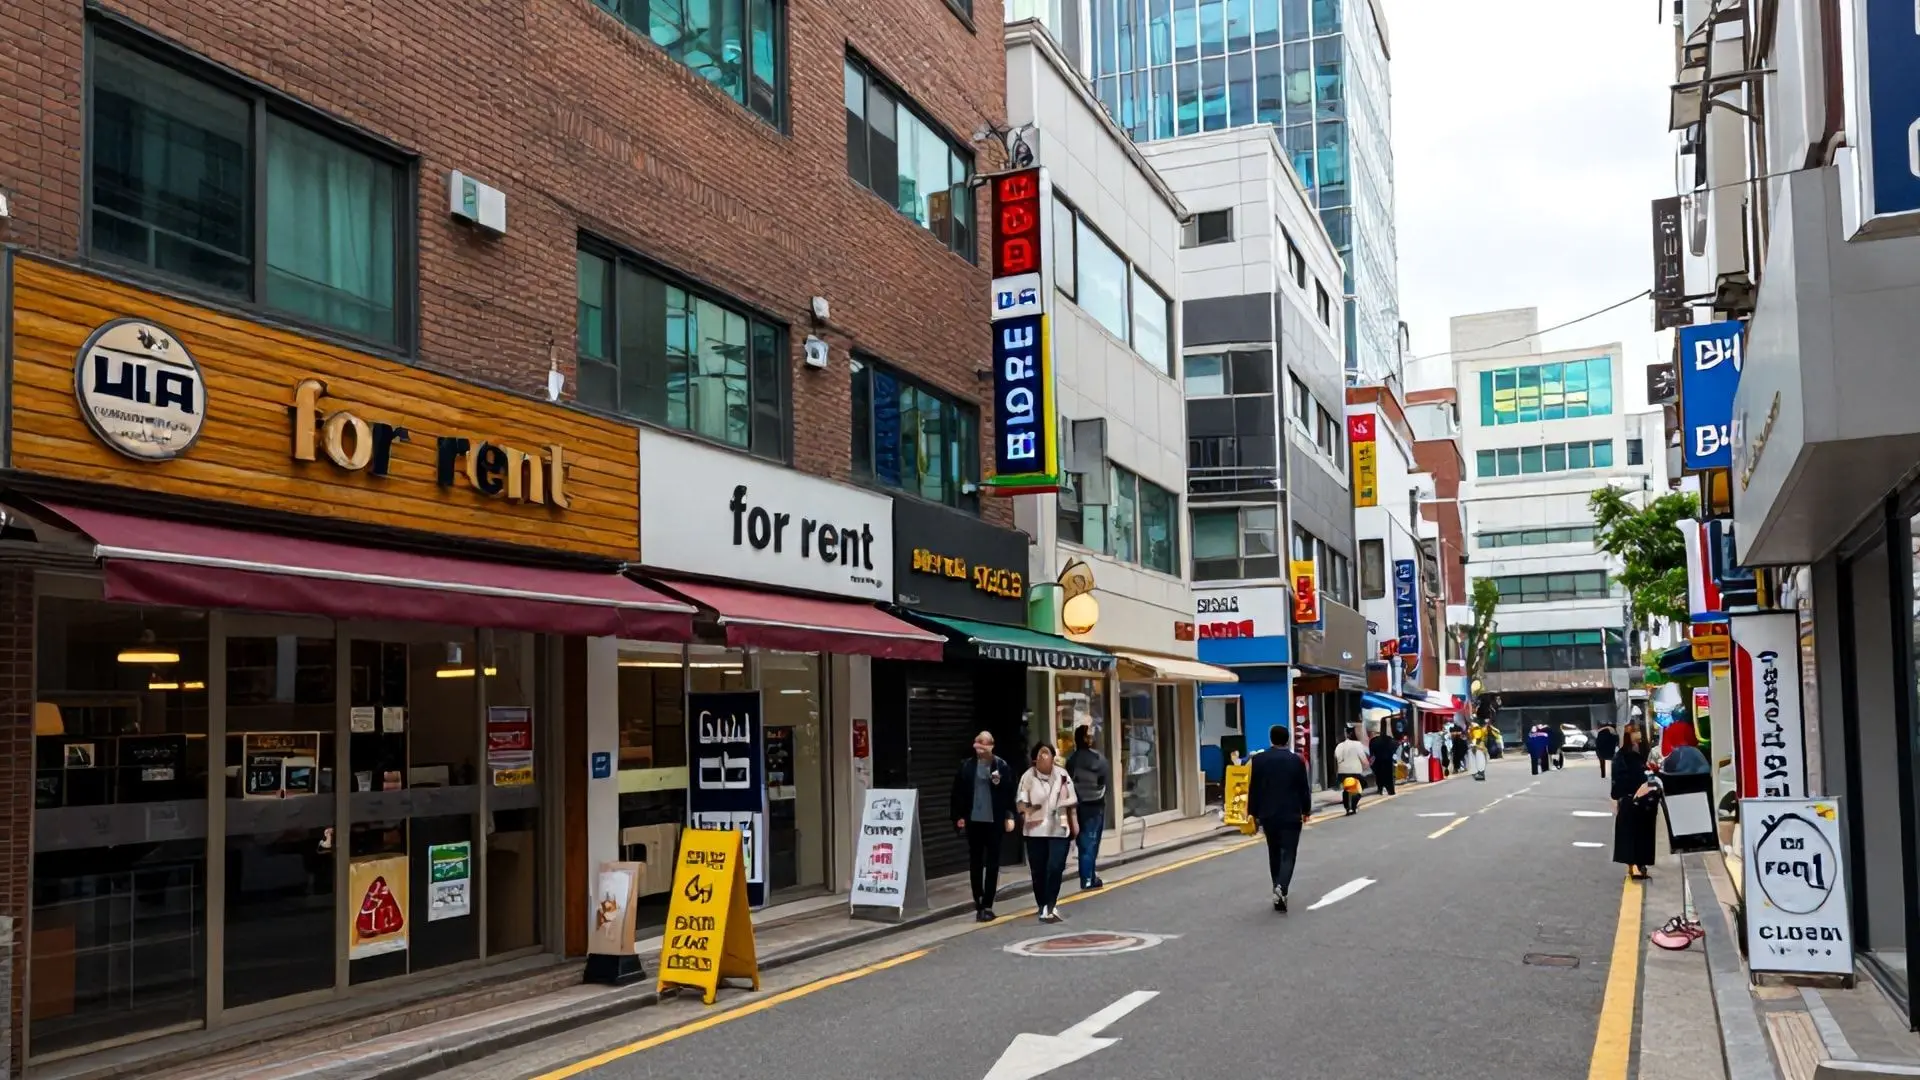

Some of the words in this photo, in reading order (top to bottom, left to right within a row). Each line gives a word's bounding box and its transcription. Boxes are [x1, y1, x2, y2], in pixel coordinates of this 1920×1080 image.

[291, 377, 410, 477] for
[436, 436, 570, 509] rent
[730, 485, 790, 553] for
[802, 518, 874, 571] rent
